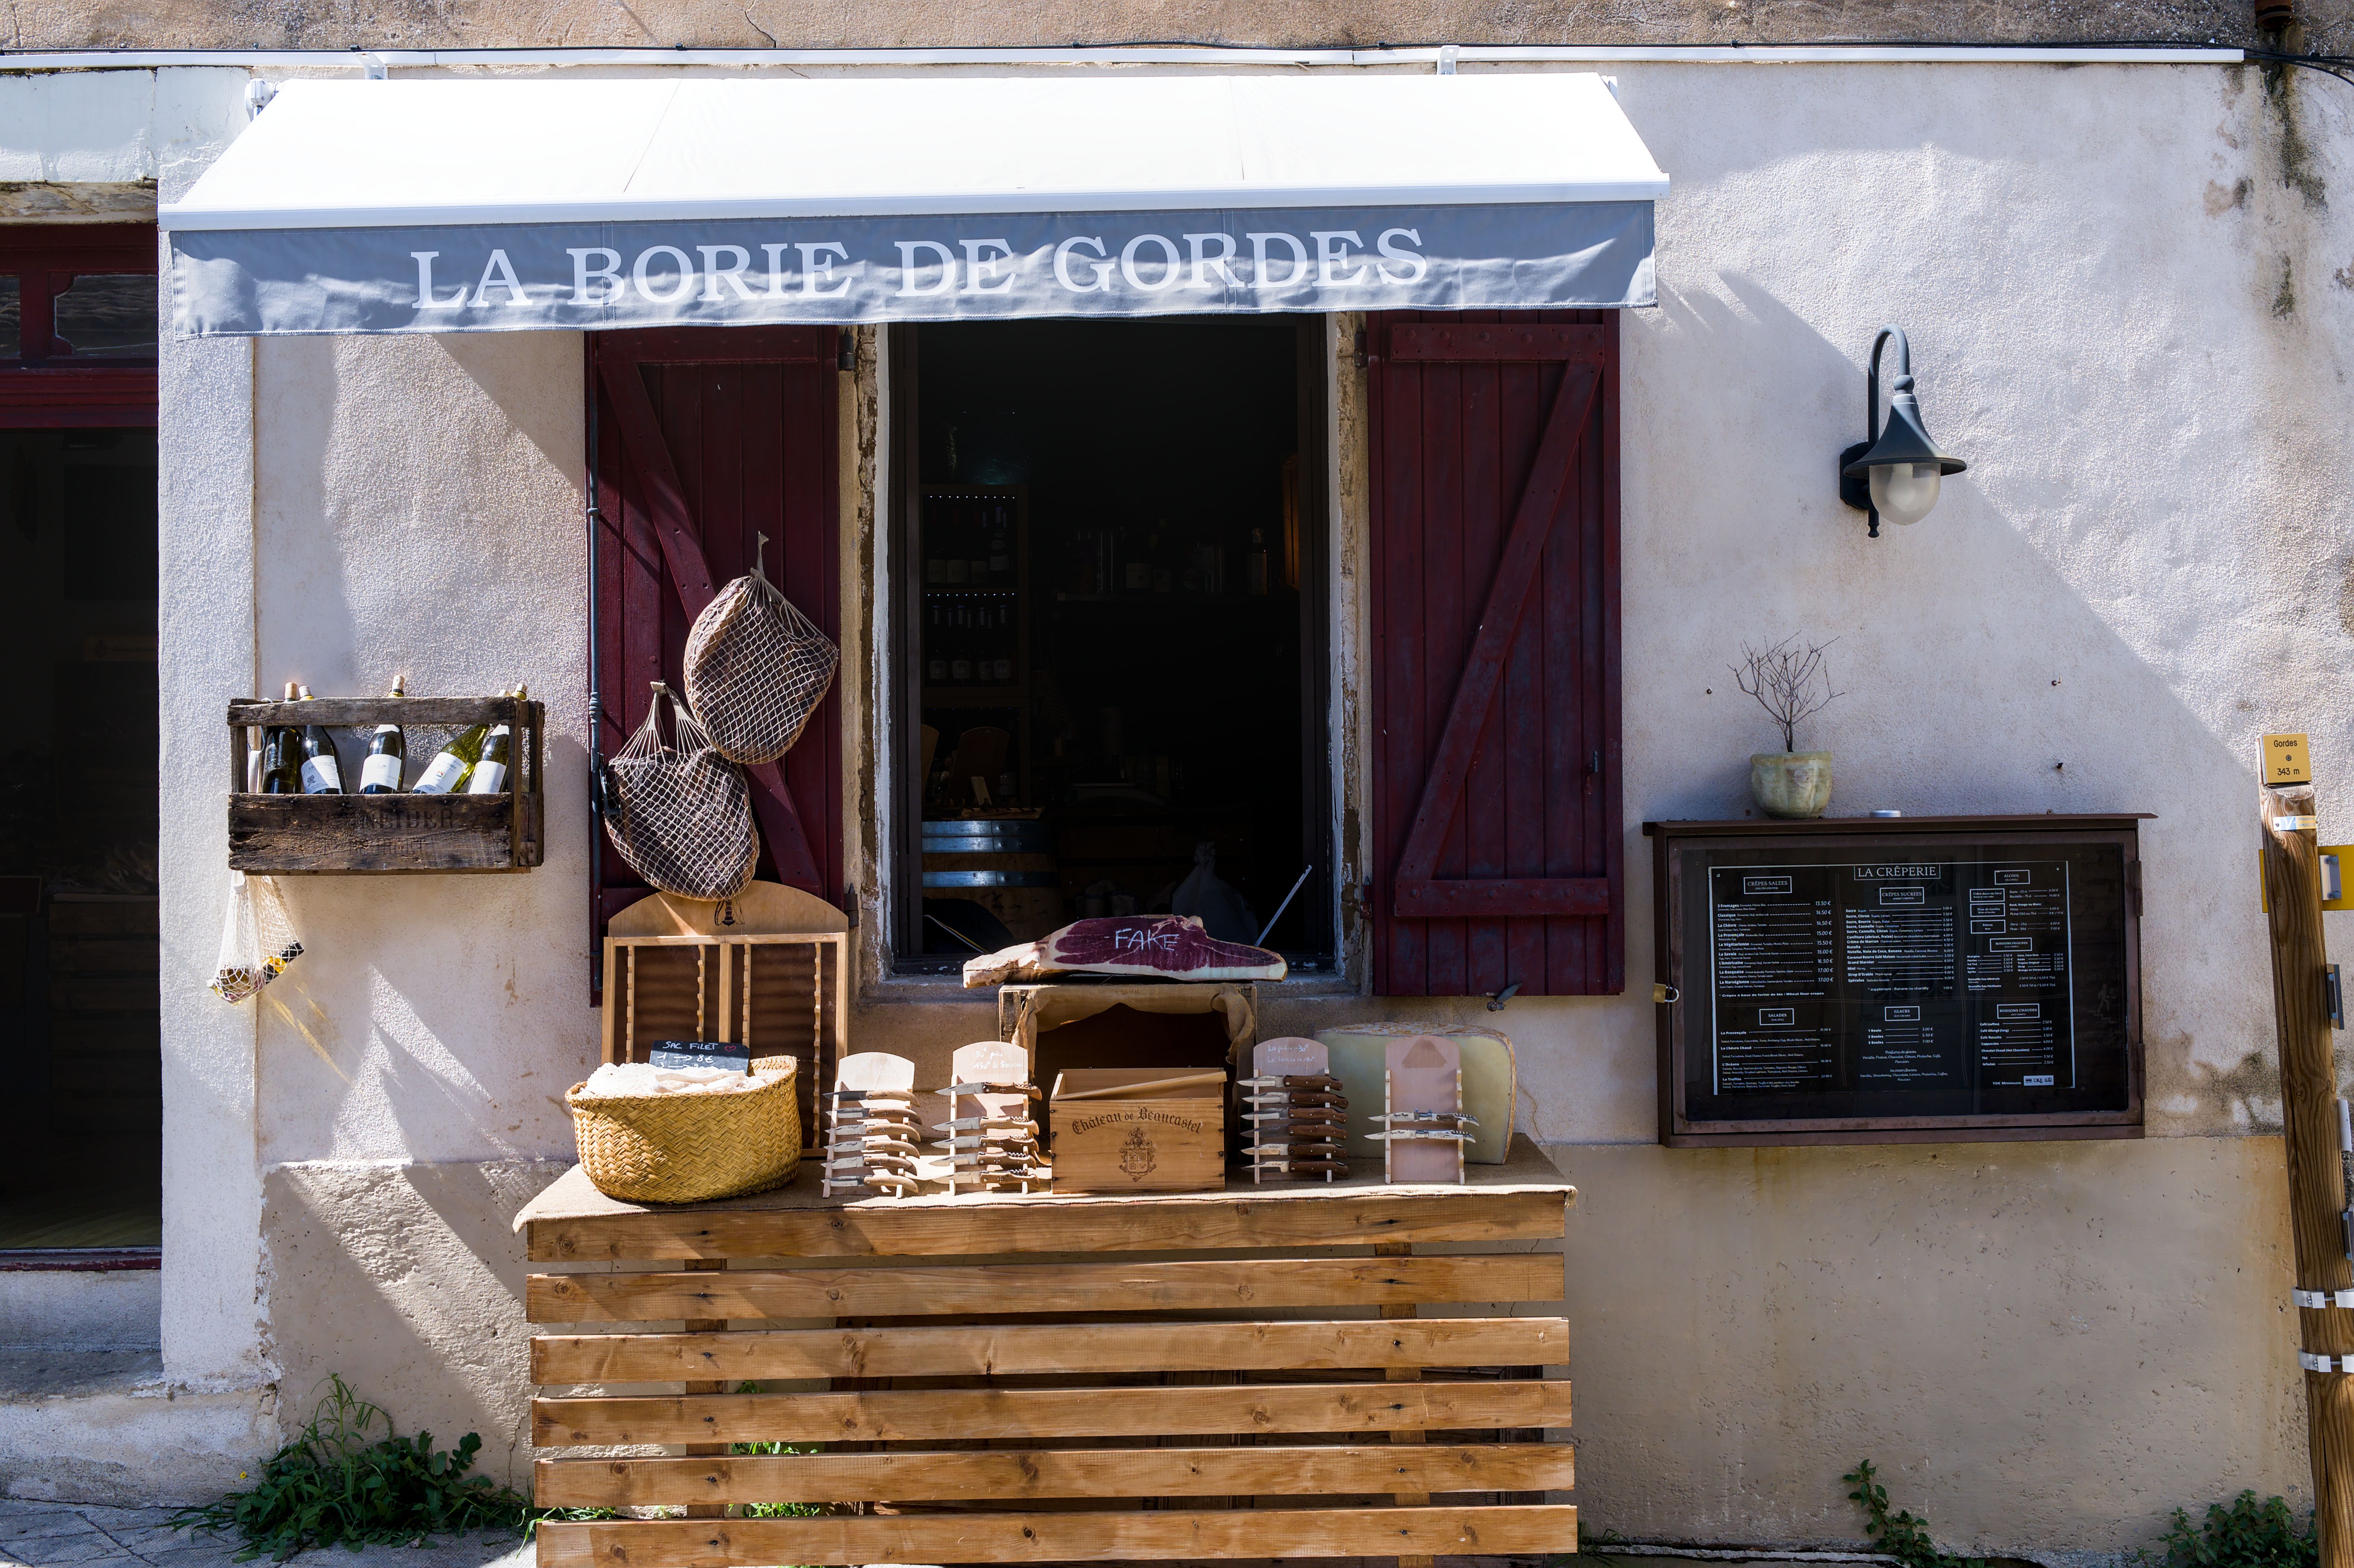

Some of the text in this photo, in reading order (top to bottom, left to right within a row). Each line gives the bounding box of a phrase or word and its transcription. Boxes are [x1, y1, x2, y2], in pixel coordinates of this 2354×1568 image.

[411, 228, 1427, 309] LA BORIE DE GORDES
[1858, 866, 1936, 877] LA CRÊPERIE
[1115, 928, 1179, 951] FAKE
[697, 1054, 713, 1063] 8€
[1072, 1106, 1201, 1134] Château de Beaucastel
